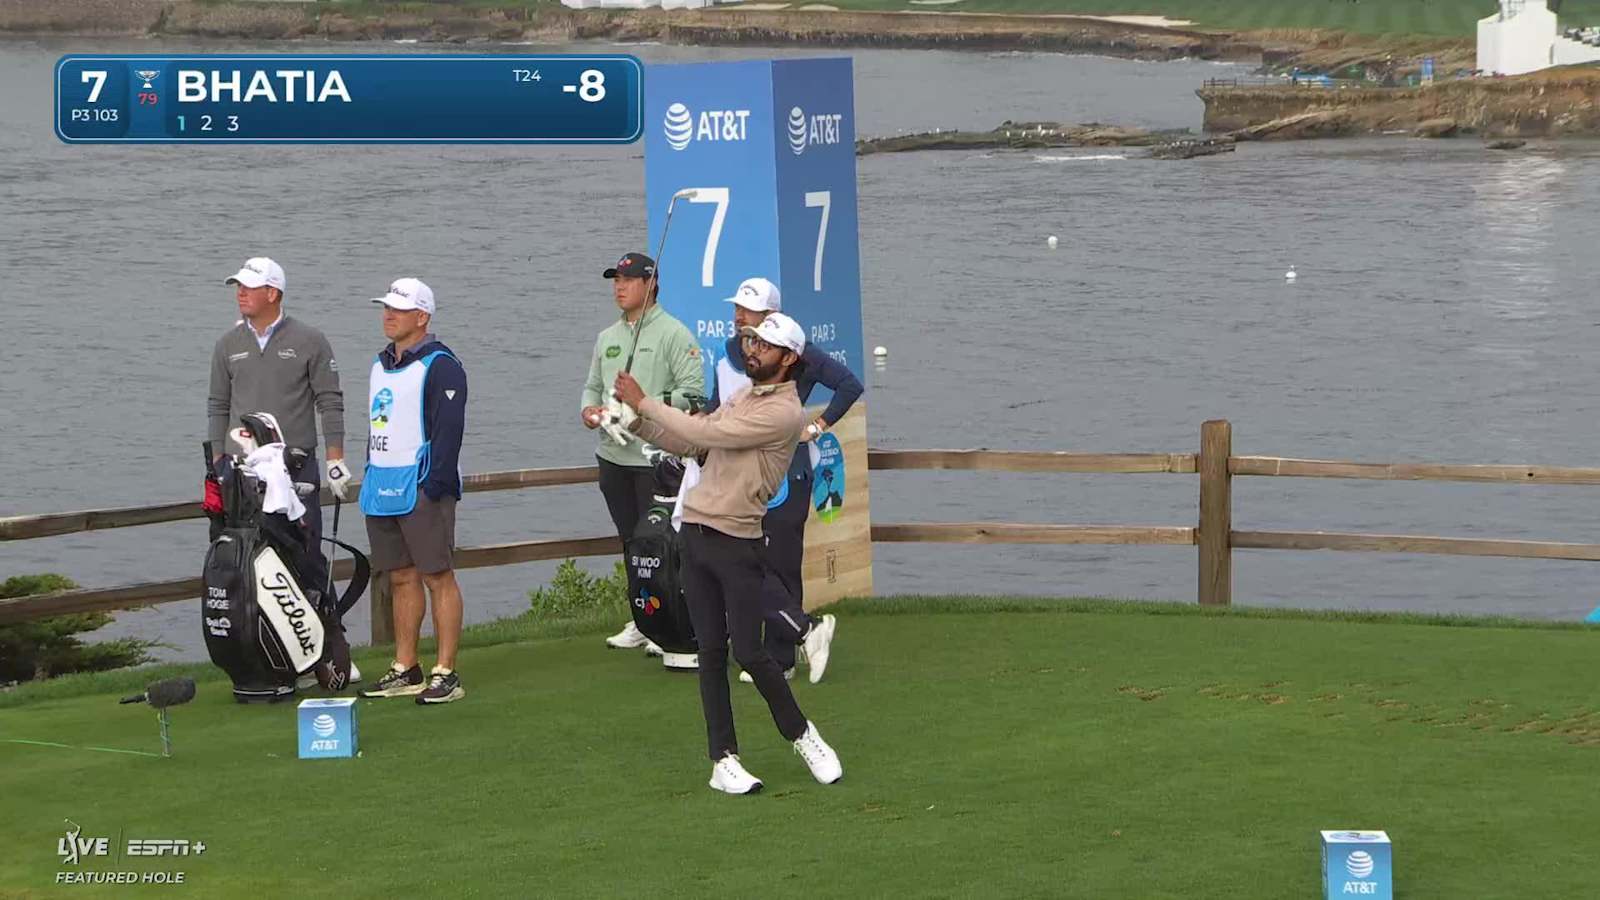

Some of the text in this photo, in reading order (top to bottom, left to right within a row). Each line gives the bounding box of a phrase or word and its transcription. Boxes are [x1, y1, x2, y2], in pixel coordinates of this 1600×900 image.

[697, 109, 750, 142] AT&T
[809, 113, 842, 145] AT&T
[689, 187, 729, 287] 7
[805, 190, 830, 291] 7
[697, 319, 736, 338] PAR 3
[811, 322, 836, 343] PAR 3
[369, 434, 389, 451] OGE
[631, 556, 661, 568] SI WOO
[637, 567, 652, 579] KIM
[208, 586, 227, 598] TOM
[261, 571, 316, 656] Titleist
[311, 739, 340, 752] AT&T
[1343, 881, 1378, 894] AT&T
